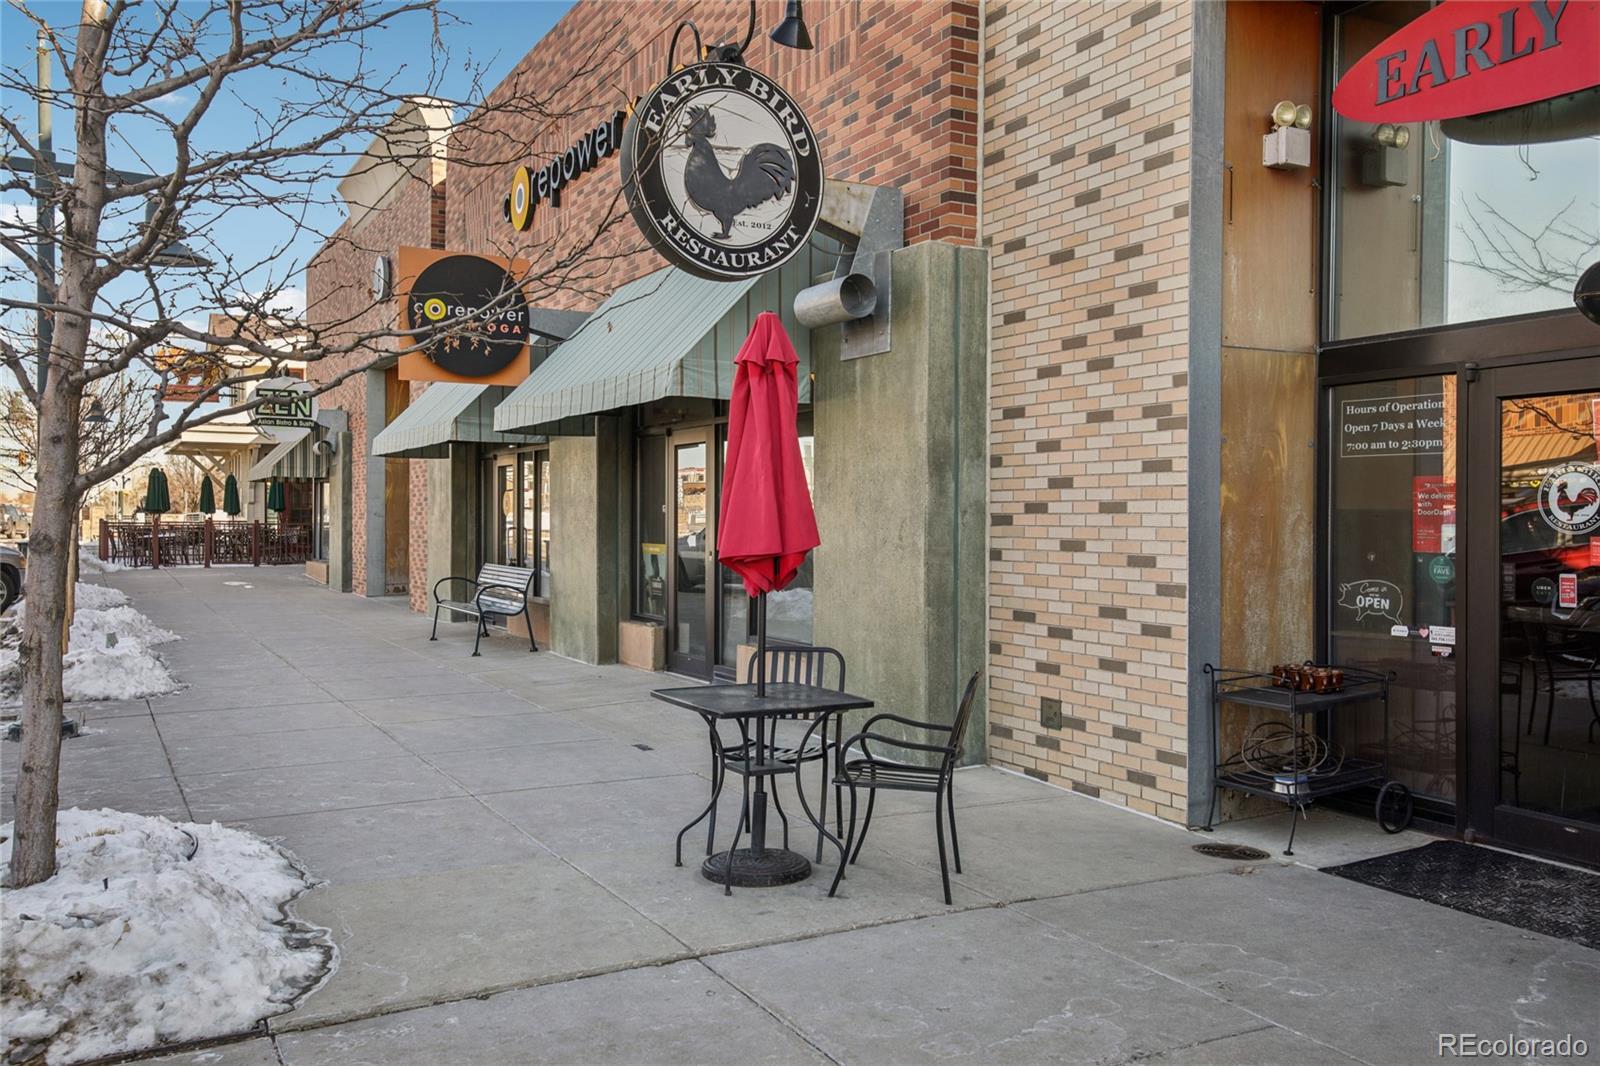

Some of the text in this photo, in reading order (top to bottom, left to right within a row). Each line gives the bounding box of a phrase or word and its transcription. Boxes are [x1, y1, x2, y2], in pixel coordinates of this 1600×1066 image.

[1375, 0, 1568, 106] EARLY
[645, 67, 810, 157] EARLY BIRD
[503, 110, 628, 231] corepower
[750, 221, 772, 230] 2012
[659, 209, 801, 269] RESTAURANT
[475, 322, 522, 334] OGA
[257, 389, 312, 417] ZEN
[1346, 399, 1445, 415] Hours of Operation
[1344, 423, 1370, 434] Open
[1372, 424, 1378, 433] 7
[1380, 421, 1405, 432] Days
[1416, 417, 1446, 429] Week
[1346, 438, 1443, 452] 7:00 am to 2:30pm
[1548, 514, 1600, 531] RESTAURANT
[1356, 594, 1390, 610] OPEN
